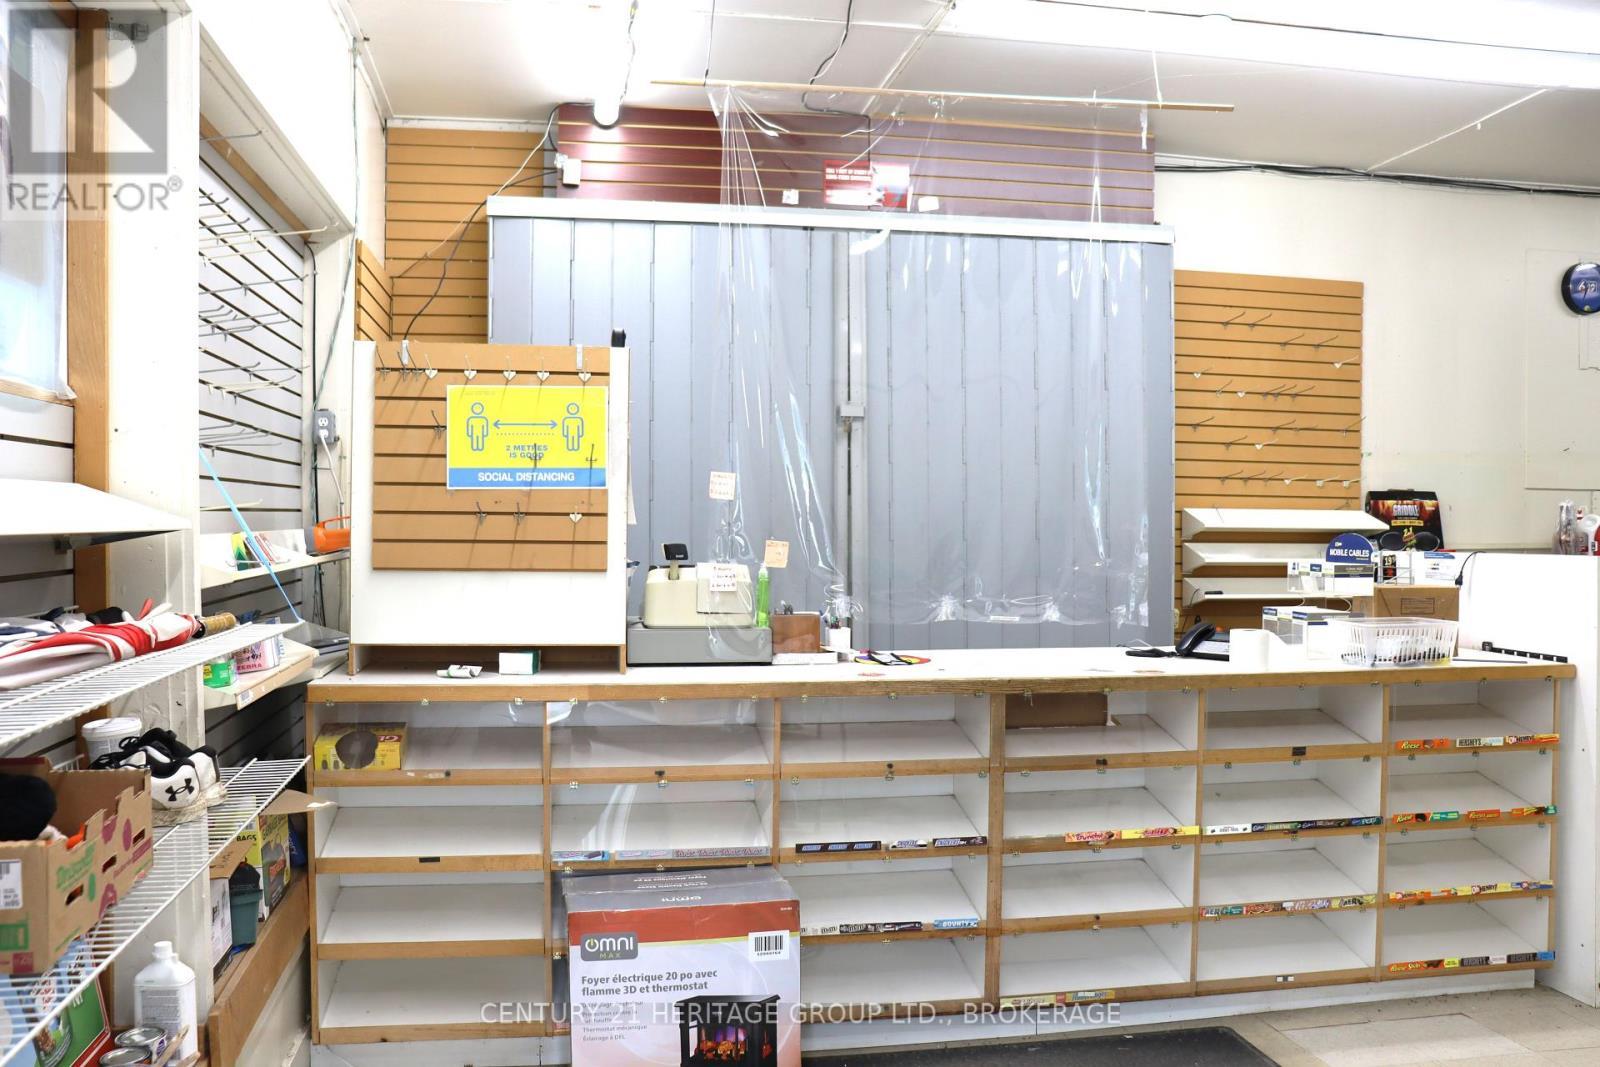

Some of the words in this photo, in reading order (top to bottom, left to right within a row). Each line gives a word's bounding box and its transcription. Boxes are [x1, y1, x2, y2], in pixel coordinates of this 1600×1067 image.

[505, 444, 511, 452] 2
[513, 444, 548, 452] METRES
[478, 472, 513, 482] SOCIAL
[516, 472, 575, 482] DISTANCING
[1349, 549, 1370, 557] CABLES
[600, 951, 621, 959] MAX
[581, 975, 609, 987] Foyer
[612, 973, 663, 985] électrique
[665, 971, 678, 980] 20
[680, 972, 693, 983] po
[695, 969, 718, 979] avec
[581, 987, 621, 997] flamme
[623, 985, 637, 995] 3D
[639, 985, 650, 994] et
[652, 981, 709, 993] thermostat
